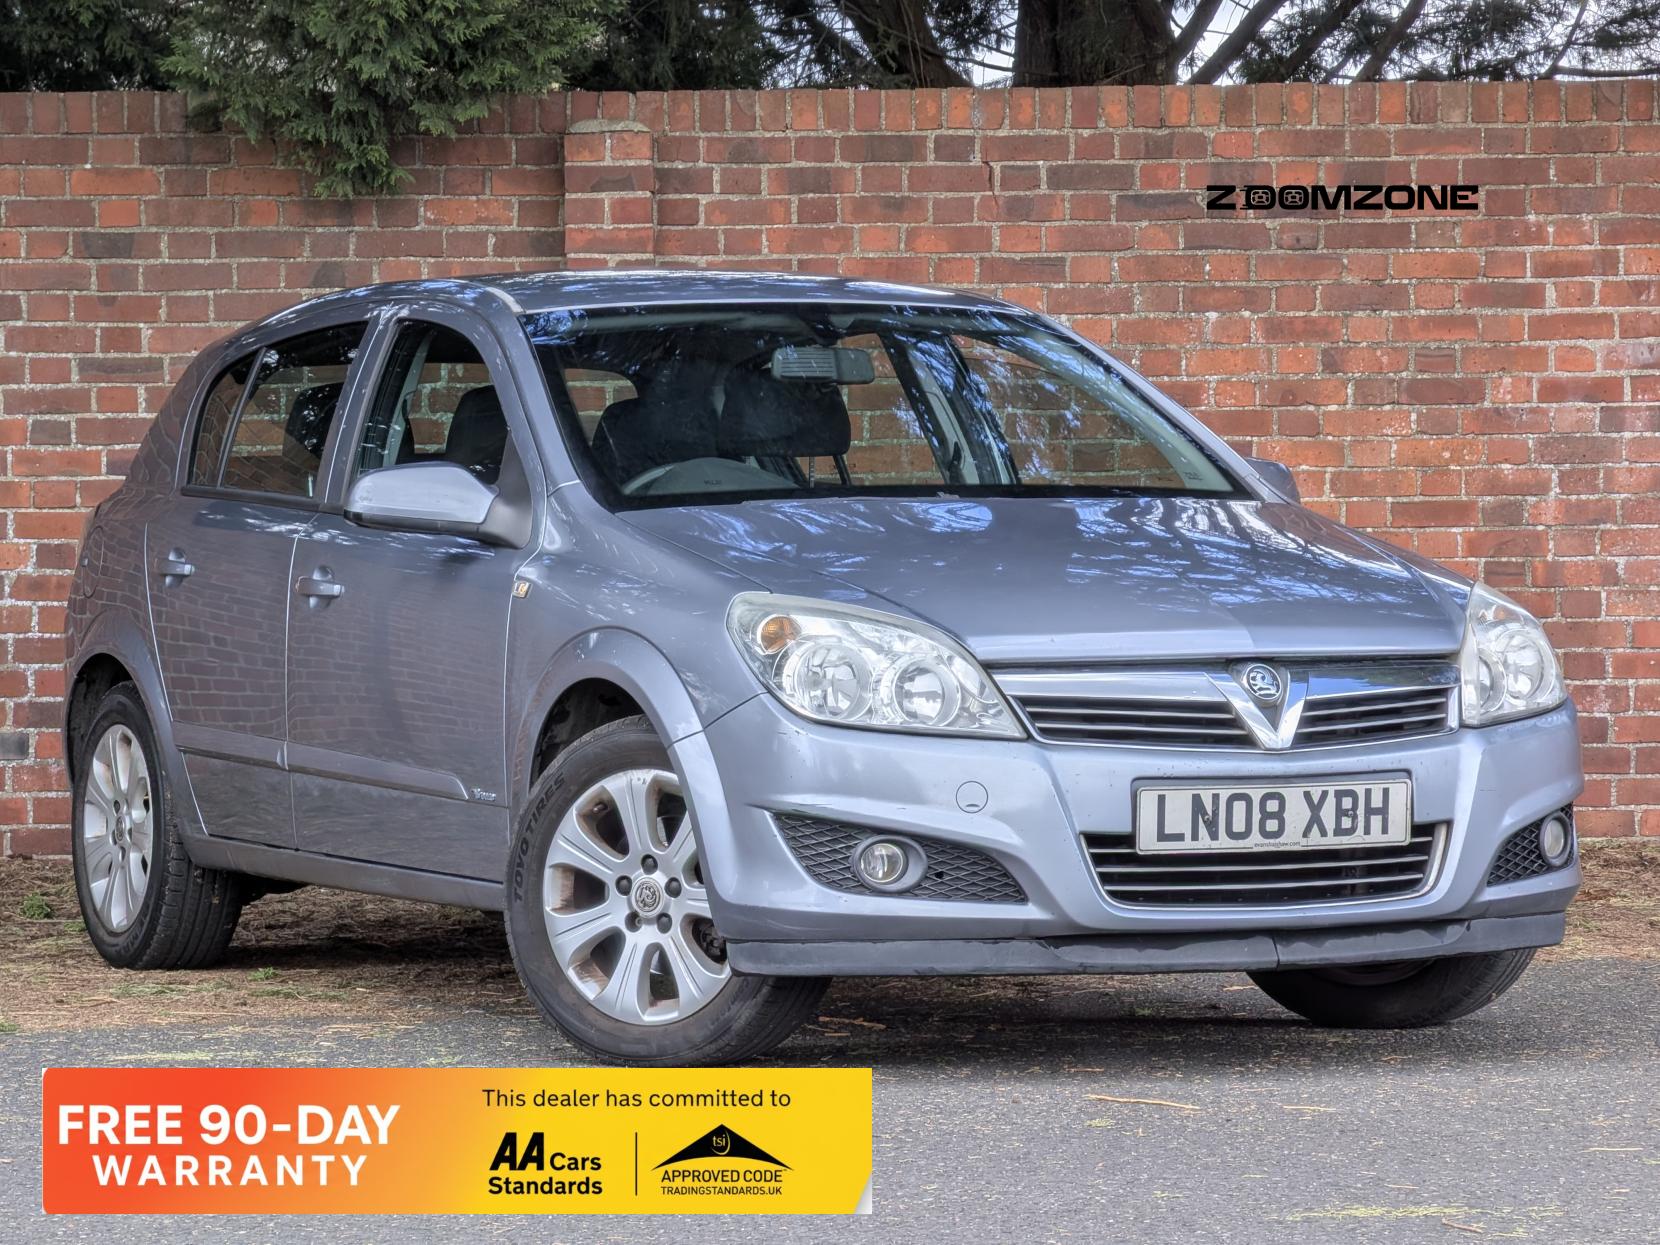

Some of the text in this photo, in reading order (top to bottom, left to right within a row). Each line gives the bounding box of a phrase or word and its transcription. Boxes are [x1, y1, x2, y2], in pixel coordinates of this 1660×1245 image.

[525, 771, 566, 835] TIRES
[1156, 787, 1390, 842] LN08 XBH
